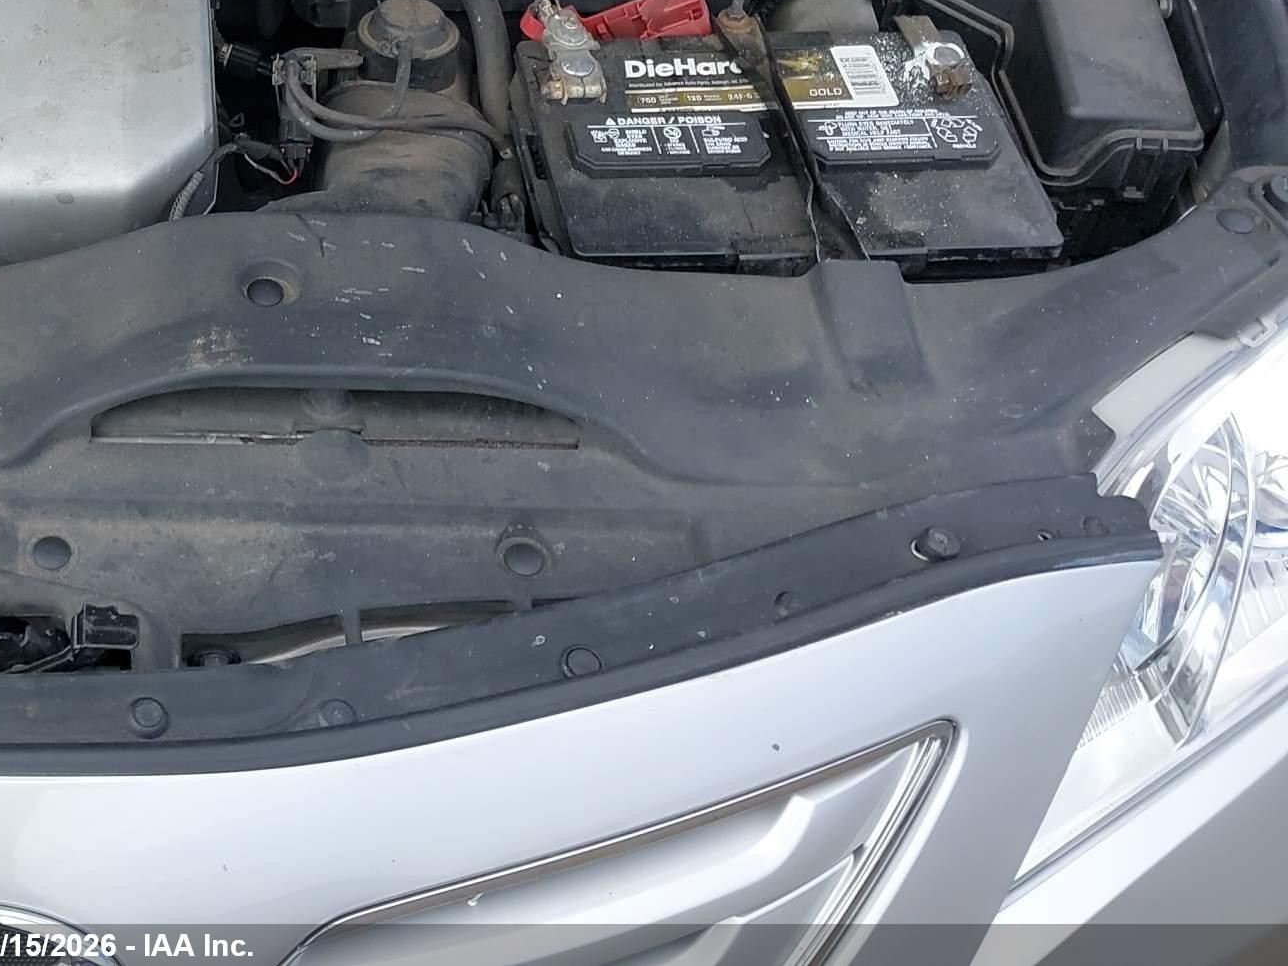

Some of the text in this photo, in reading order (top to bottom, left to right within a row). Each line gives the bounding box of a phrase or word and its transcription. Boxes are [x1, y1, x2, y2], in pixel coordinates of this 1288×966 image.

[809, 87, 842, 96] GOLD
[617, 117, 666, 125] DANGER
[678, 115, 722, 124] POISON
